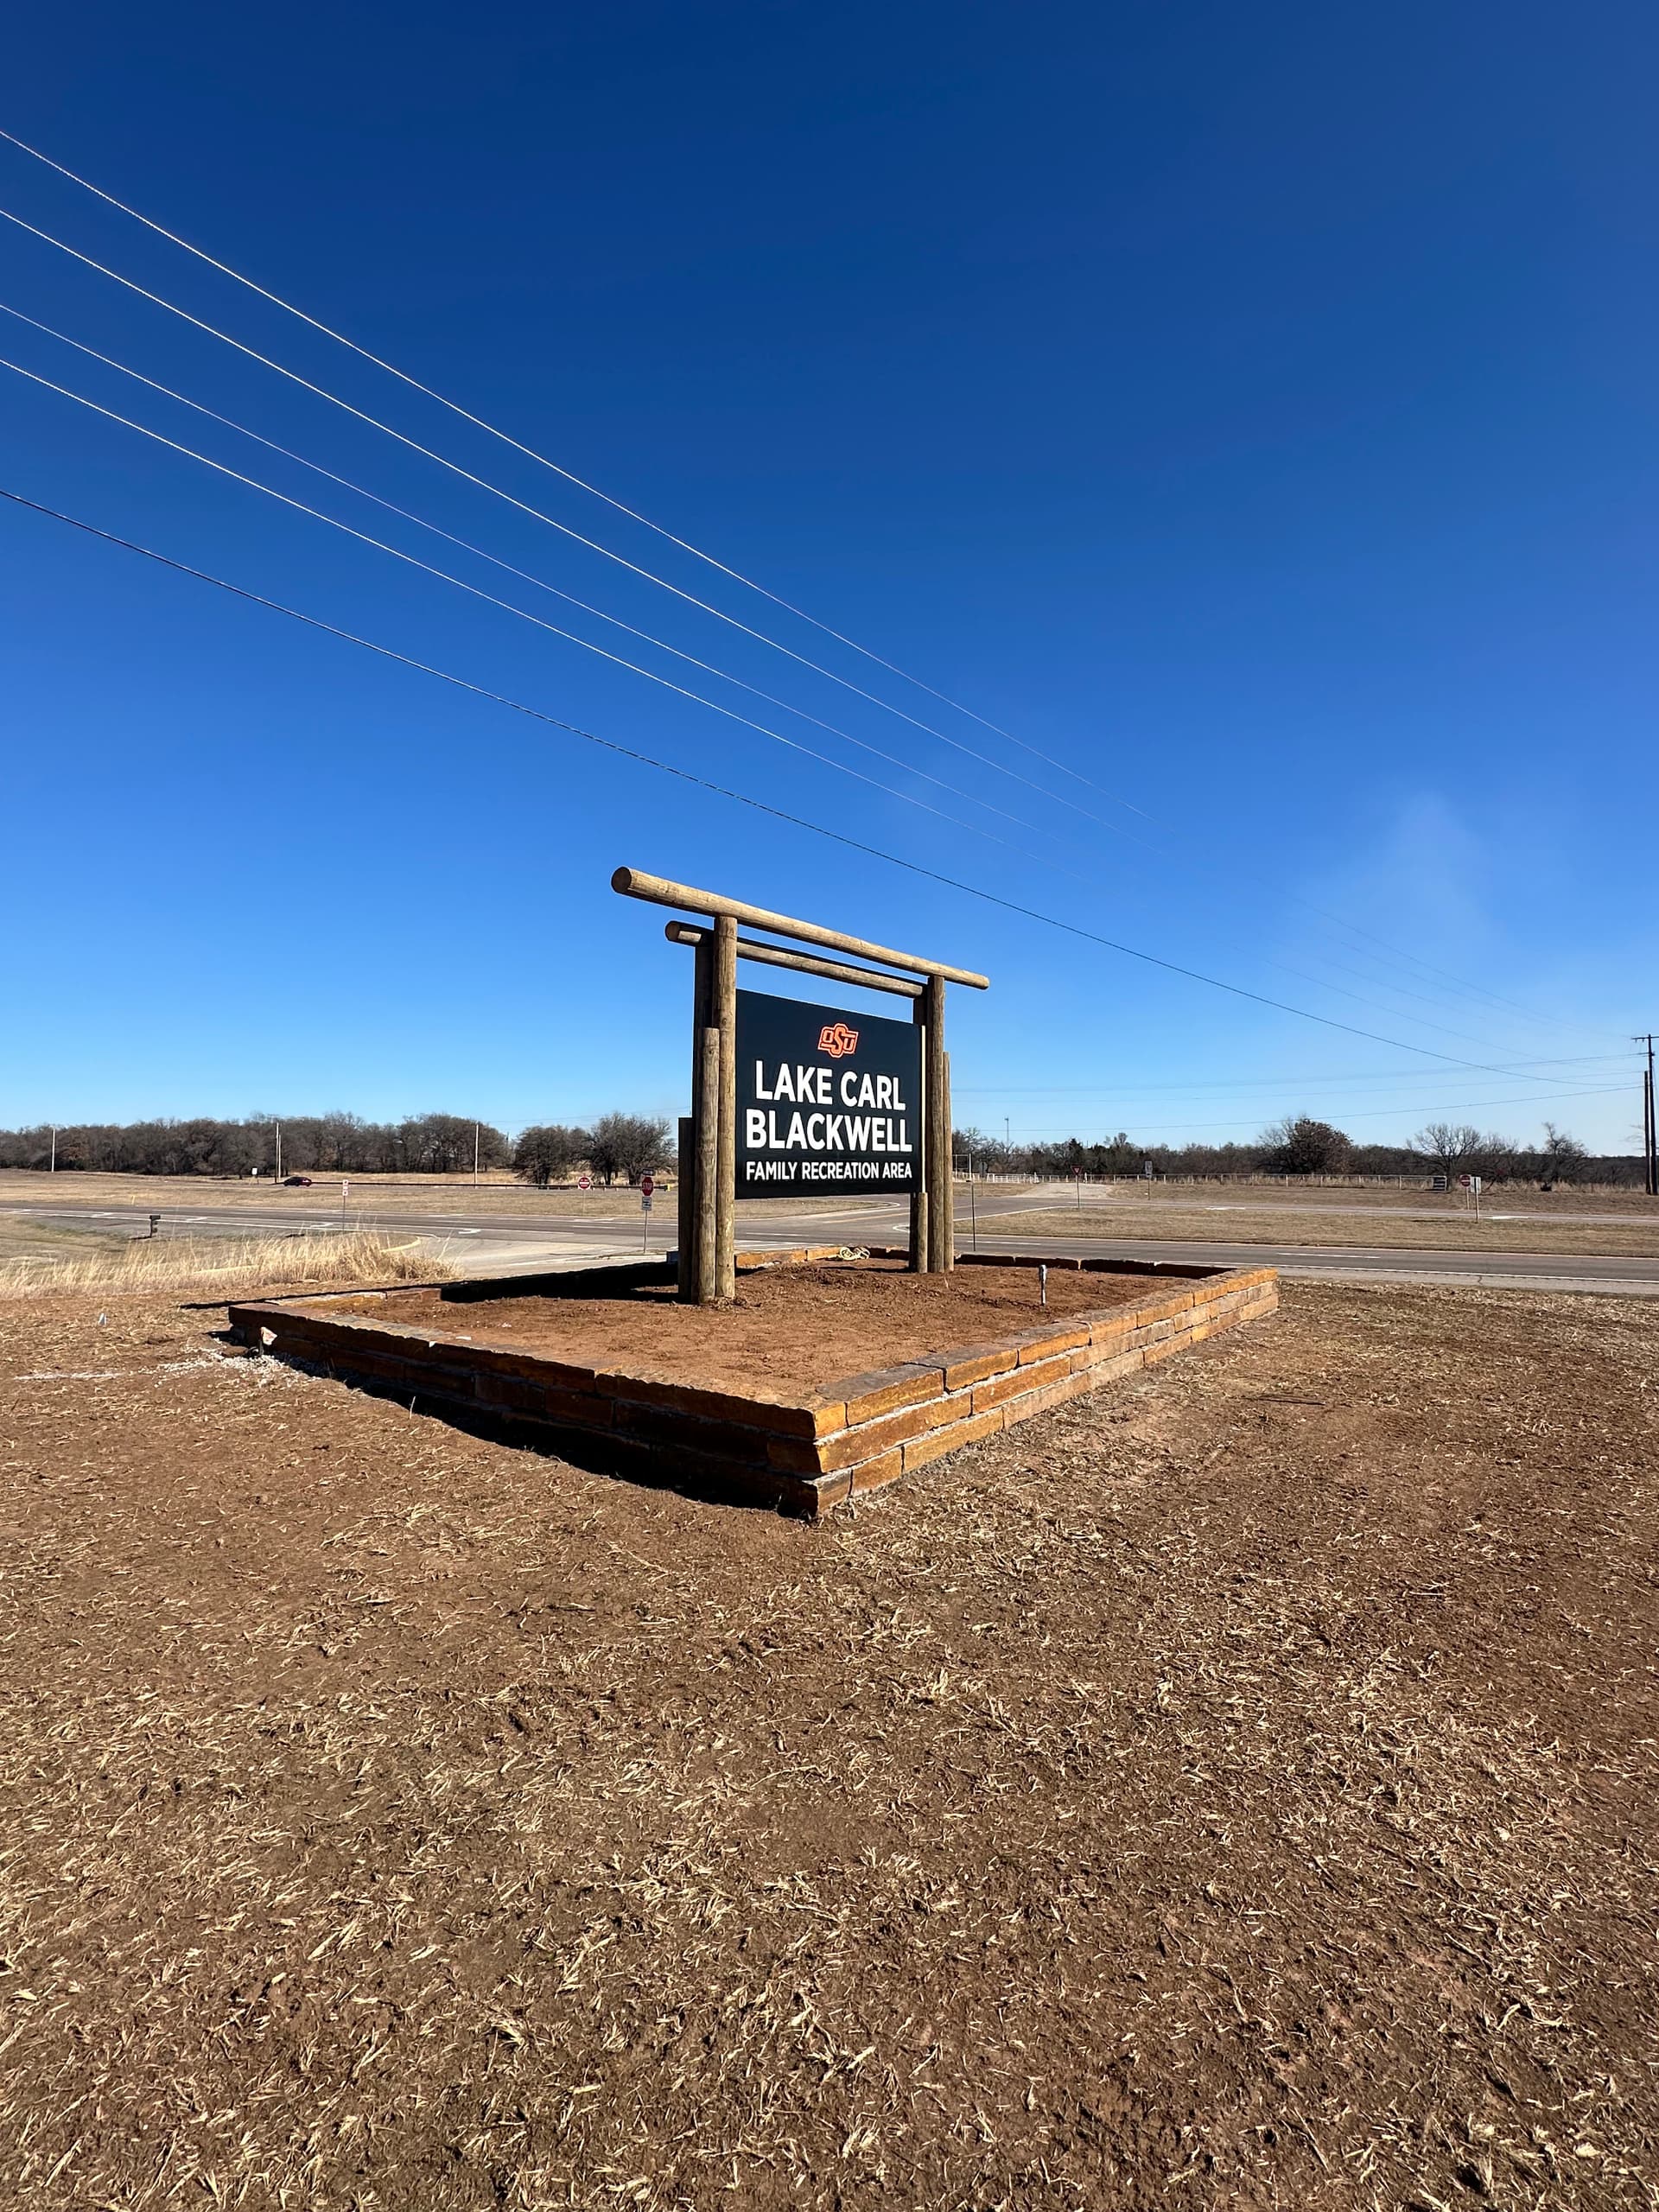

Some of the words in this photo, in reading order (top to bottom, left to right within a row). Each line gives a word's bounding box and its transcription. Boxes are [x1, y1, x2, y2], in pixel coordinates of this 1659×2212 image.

[817, 1023, 859, 1058] OSU
[755, 1060, 833, 1105] LAKE
[840, 1071, 906, 1110] CARL
[746, 1109, 912, 1152] BLACKWELL
[746, 1161, 798, 1180] FAMILY
[801, 1161, 879, 1179] RECREATION
[882, 1162, 912, 1179] AREA
